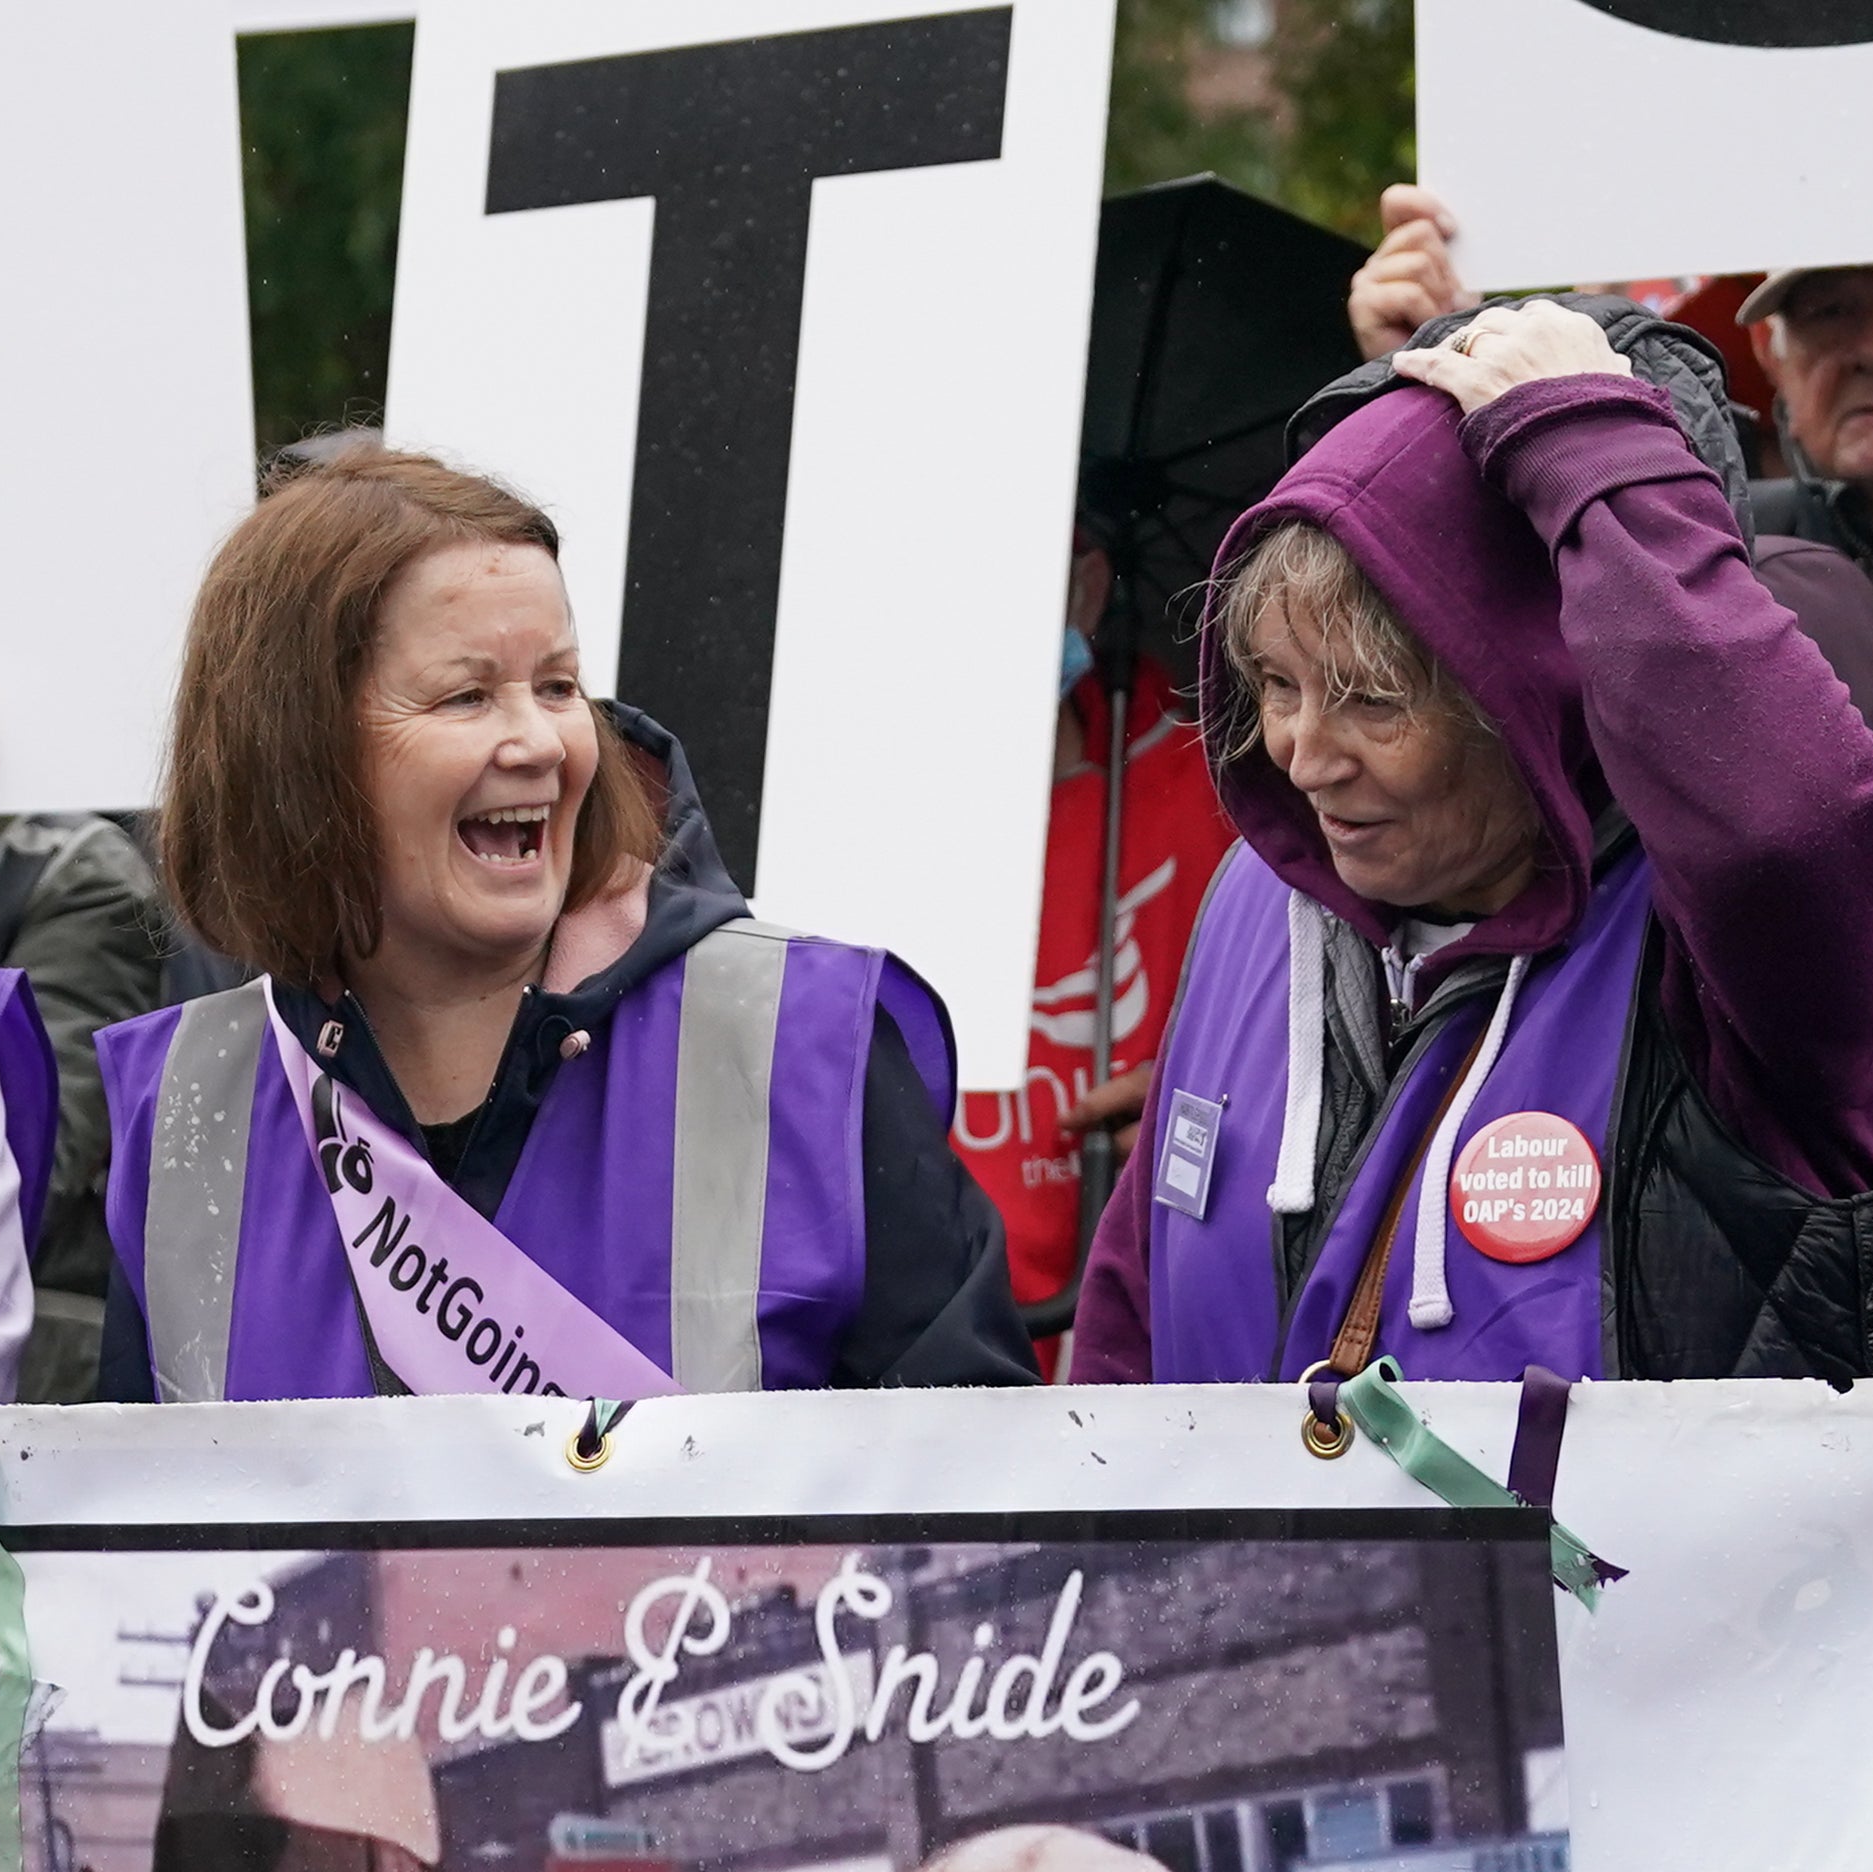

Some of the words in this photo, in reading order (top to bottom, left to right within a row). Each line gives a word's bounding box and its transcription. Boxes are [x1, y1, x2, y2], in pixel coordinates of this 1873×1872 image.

[484, 4, 1014, 898] T
[1460, 1166, 1523, 1191] voted
[1528, 1167, 1551, 1189] to
[1556, 1164, 1593, 1188] kill
[1487, 1135, 1568, 1159] Labour
[1463, 1198, 1526, 1223] OAP's
[1530, 1198, 1585, 1221] 2024
[351, 1195, 571, 1397] NotGoin
[182, 1580, 582, 1749] Connie
[616, 1555, 732, 1763] &
[758, 1549, 1141, 1771] Snide
